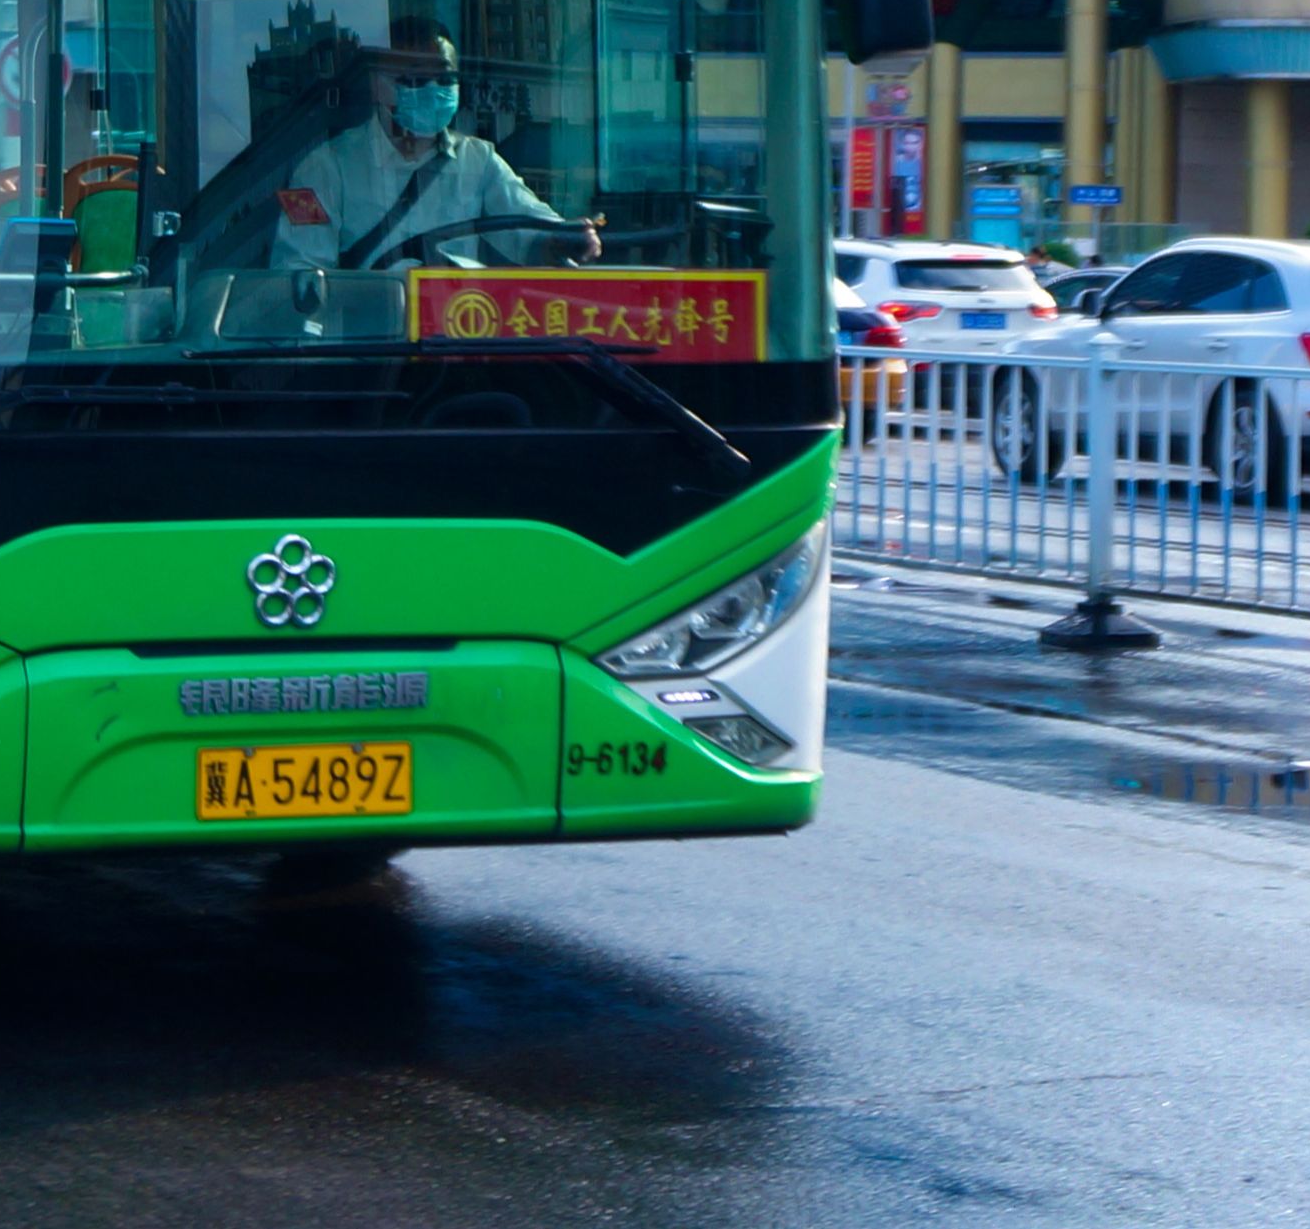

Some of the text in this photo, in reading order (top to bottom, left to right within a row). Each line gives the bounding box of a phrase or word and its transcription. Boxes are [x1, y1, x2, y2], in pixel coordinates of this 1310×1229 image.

[504, 296, 735, 347] 全国工人先锋号
[179, 670, 429, 717] 银隆新能源
[566, 741, 668, 776] 9-6134
